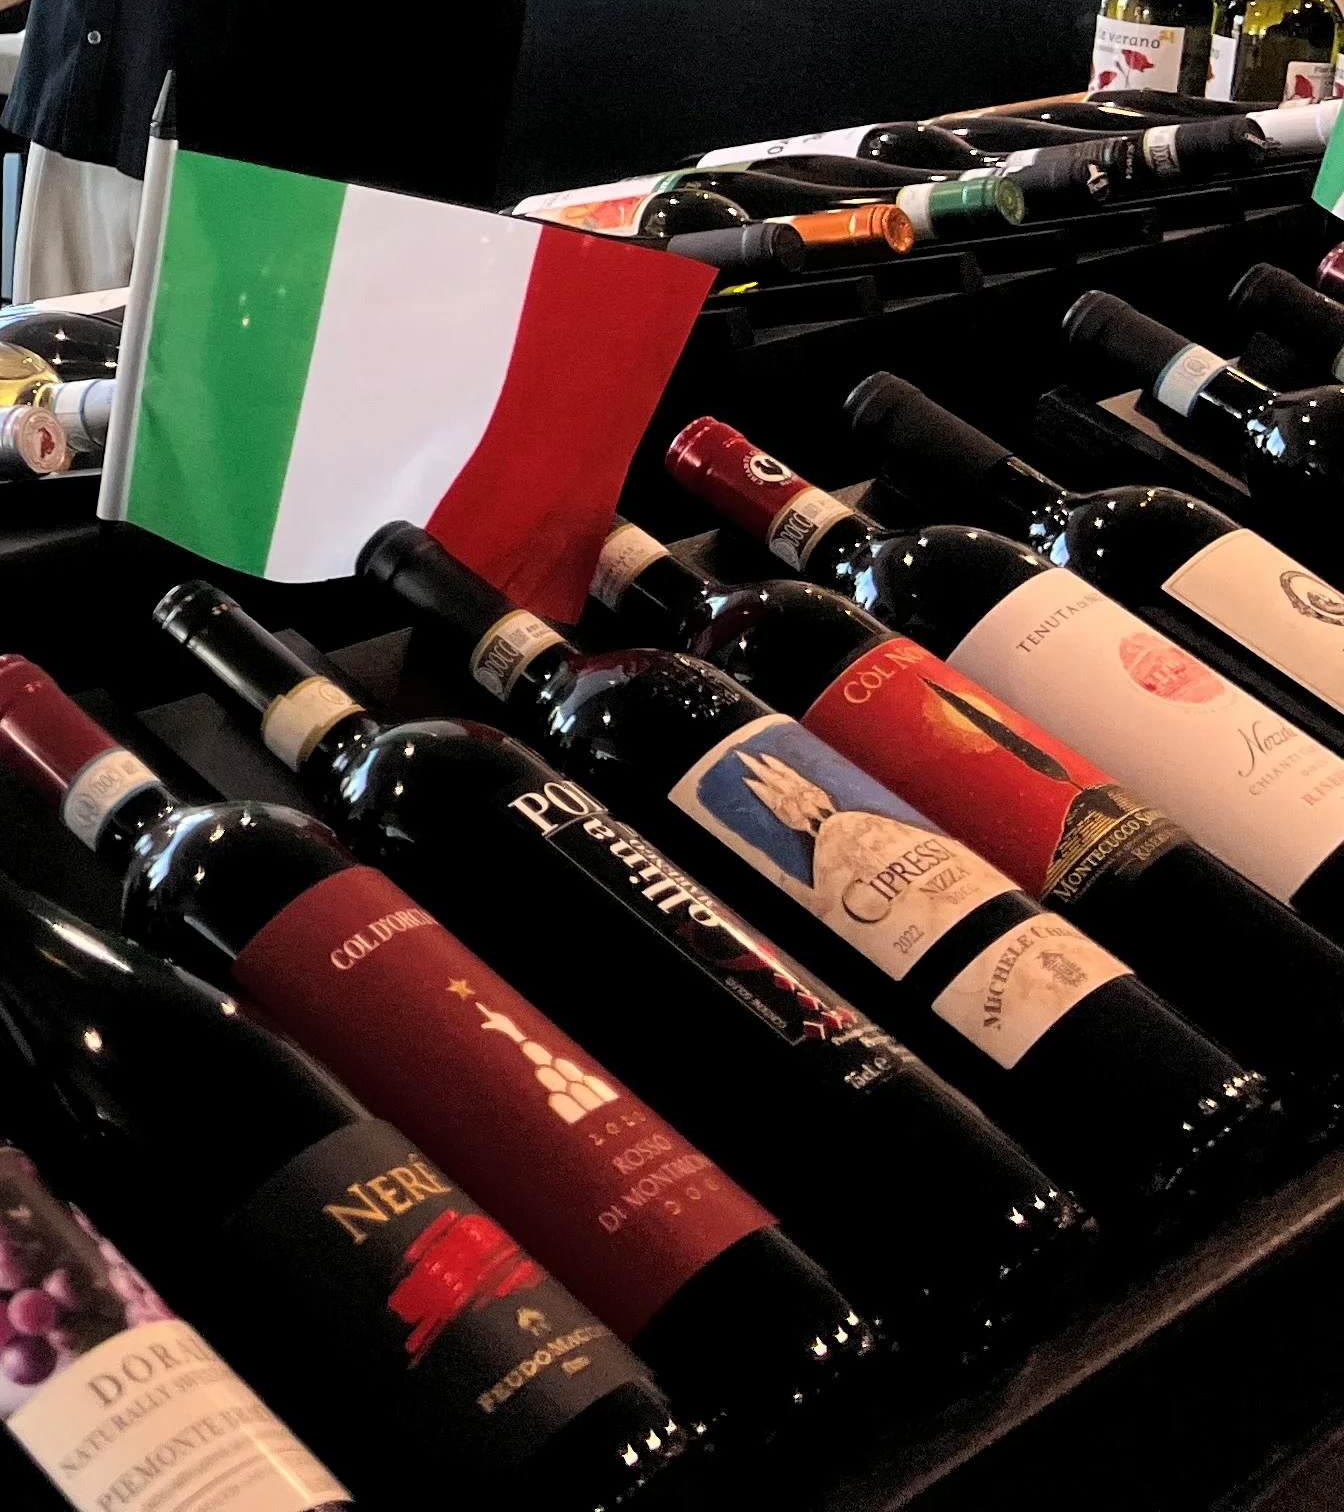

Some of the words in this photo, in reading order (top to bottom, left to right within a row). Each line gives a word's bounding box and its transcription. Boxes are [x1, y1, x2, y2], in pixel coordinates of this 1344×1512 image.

[1016, 602, 1079, 654] TENUTA
[1248, 752, 1302, 796] CHIANTI
[842, 838, 957, 925] CIPRESSI
[919, 866, 970, 900] NIZZA
[1054, 819, 1141, 904] MONTECUCCO
[330, 933, 378, 970] COL
[893, 924, 926, 956] 2022
[983, 933, 1033, 1029] MICHELE
[612, 1133, 673, 1176] ROSSO
[597, 1205, 627, 1234] DI
